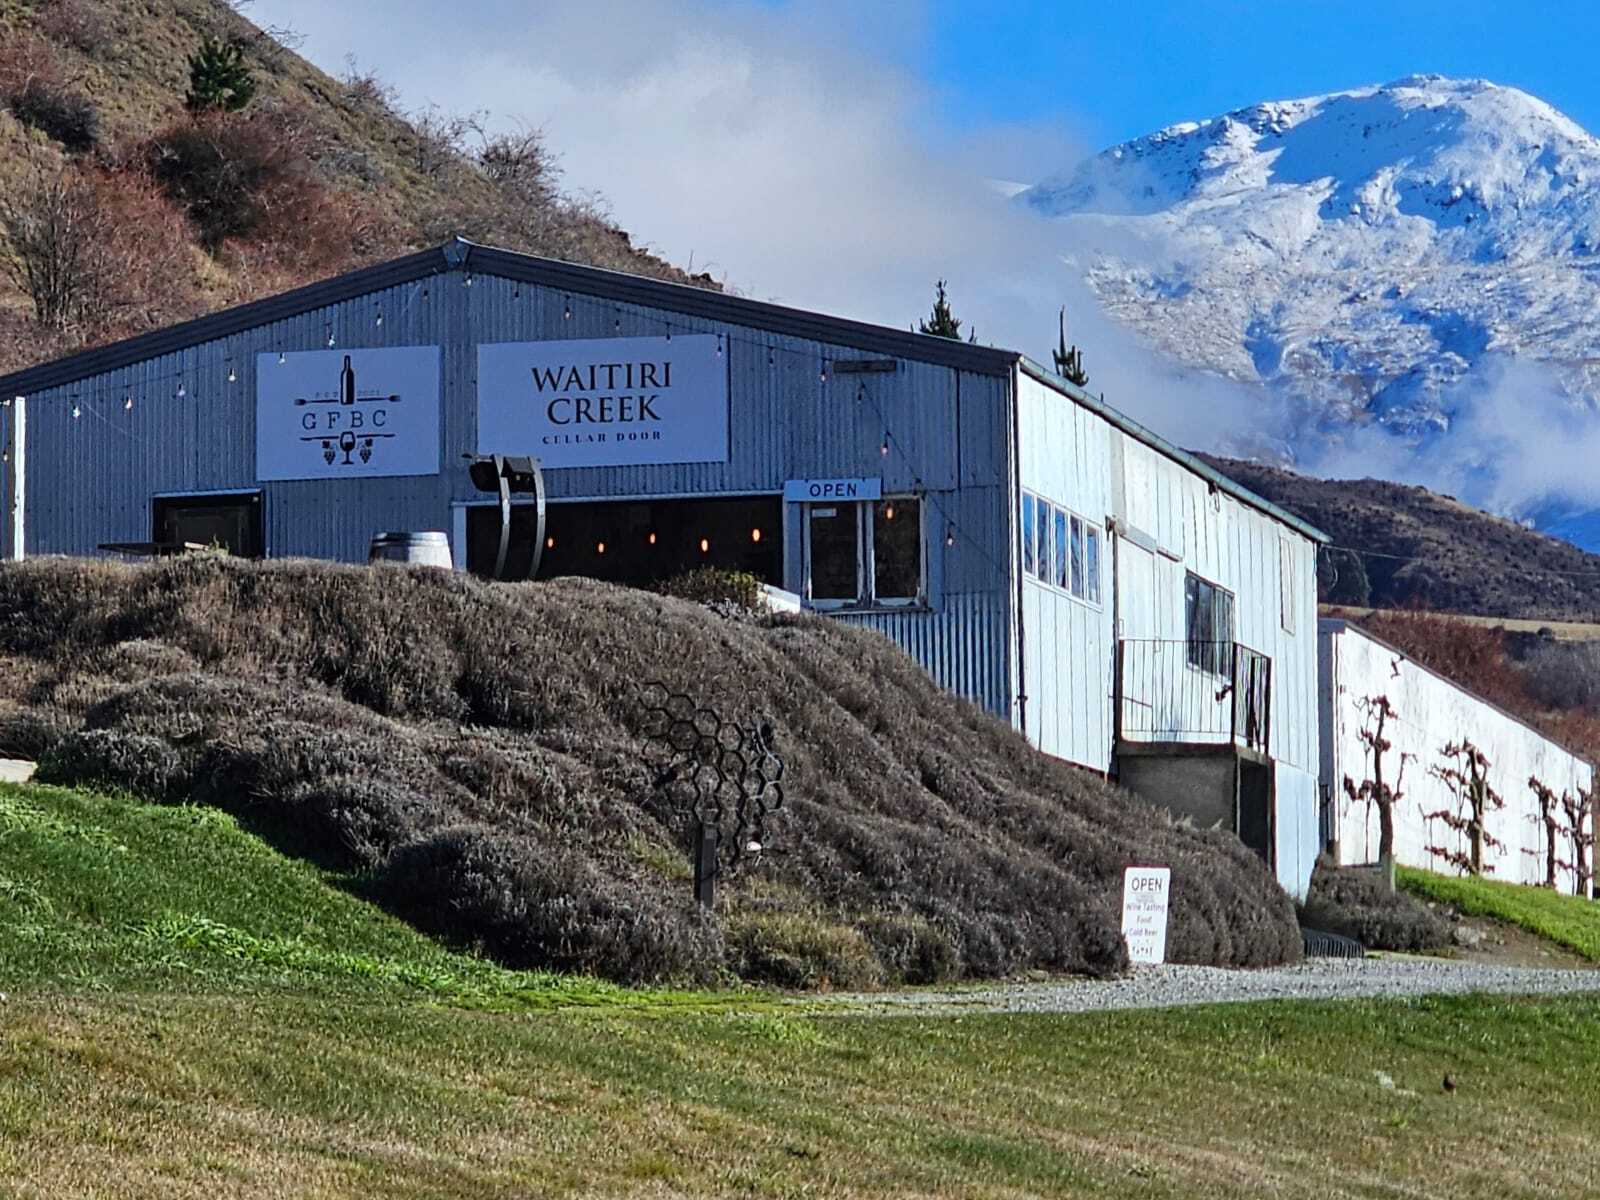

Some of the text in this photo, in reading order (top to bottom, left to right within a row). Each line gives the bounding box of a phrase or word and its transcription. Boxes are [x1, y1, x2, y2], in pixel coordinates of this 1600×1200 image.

[531, 362, 672, 392] WAITIRI
[547, 395, 662, 425] CREEK
[542, 431, 662, 444] CELLAR DOOR
[810, 484, 857, 497] OPEN
[1131, 877, 1162, 891] OPEN
